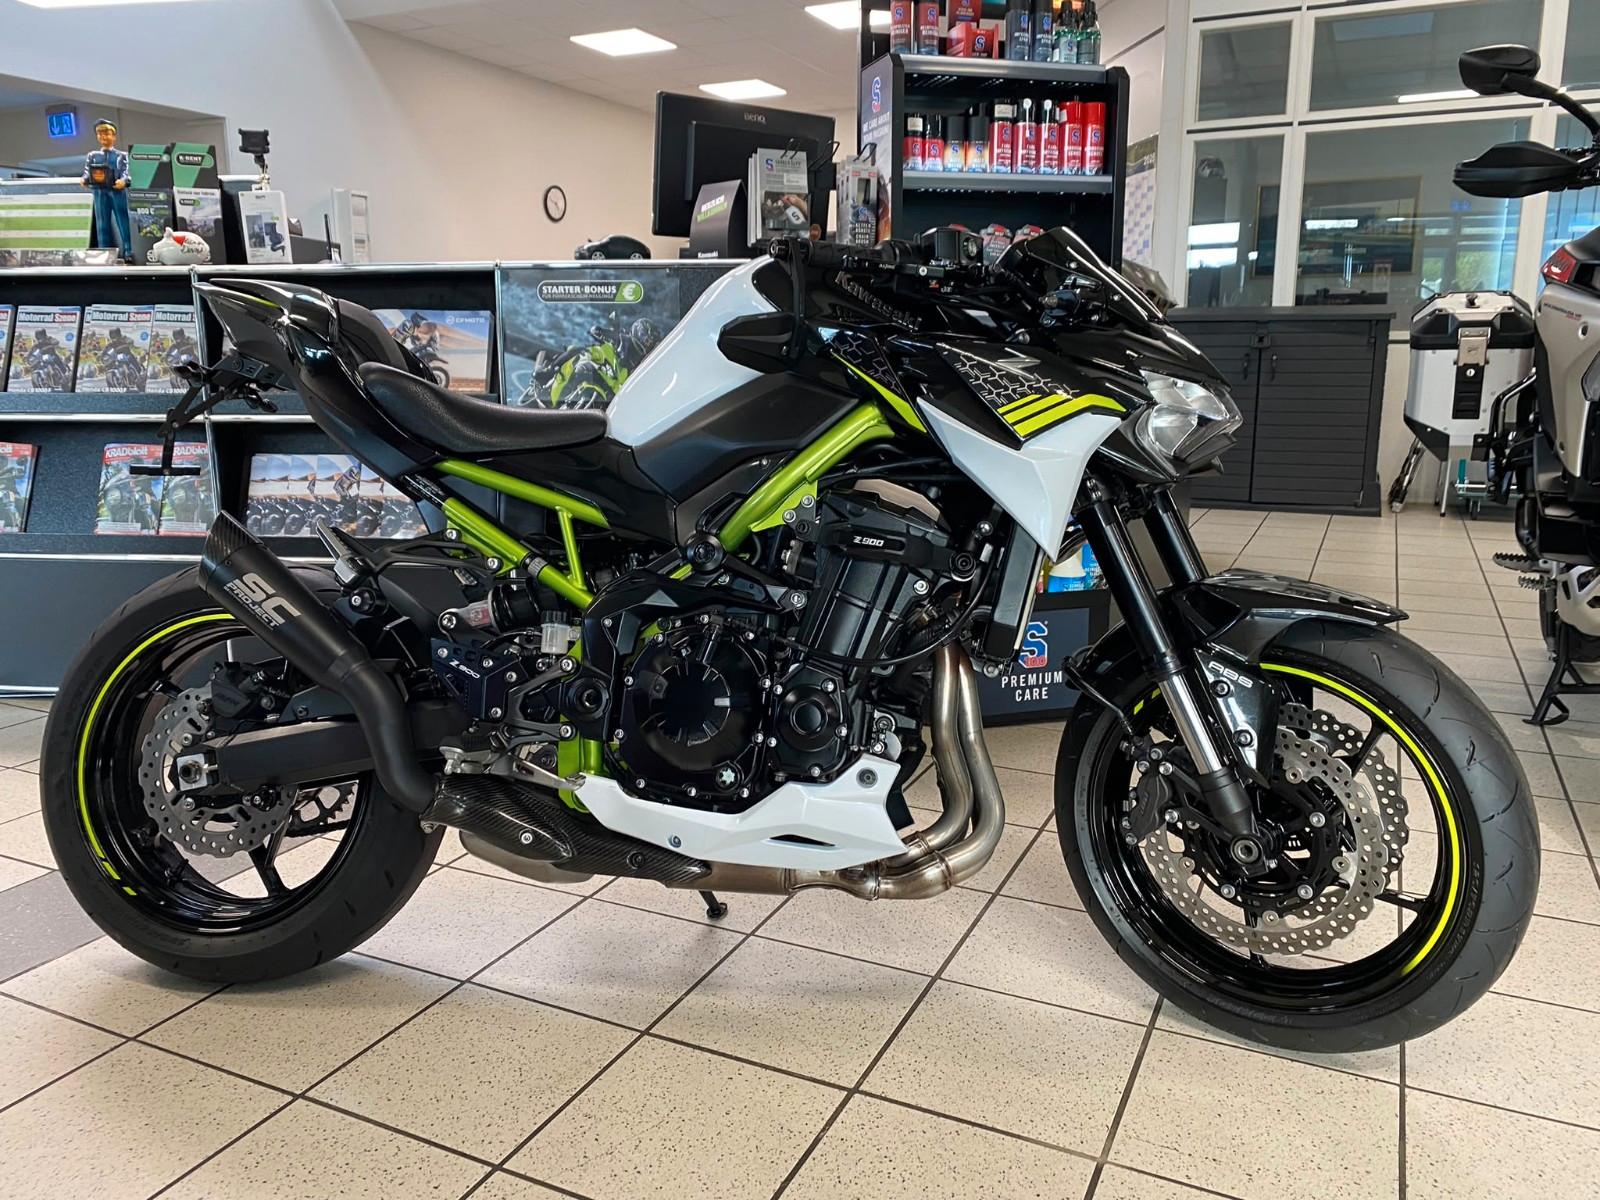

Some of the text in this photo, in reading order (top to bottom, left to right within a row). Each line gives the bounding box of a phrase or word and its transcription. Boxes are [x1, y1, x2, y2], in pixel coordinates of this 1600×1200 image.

[18, 312, 54, 321] Motorrad
[54, 313, 76, 322] Szene
[92, 311, 151, 321] Motorrad Szene
[155, 311, 192, 321] Motorrad
[223, 582, 280, 627] PROJECT
[1001, 670, 1063, 688] PREMIUM
[1208, 661, 1254, 689] ABS
[1015, 687, 1049, 702] CARE
